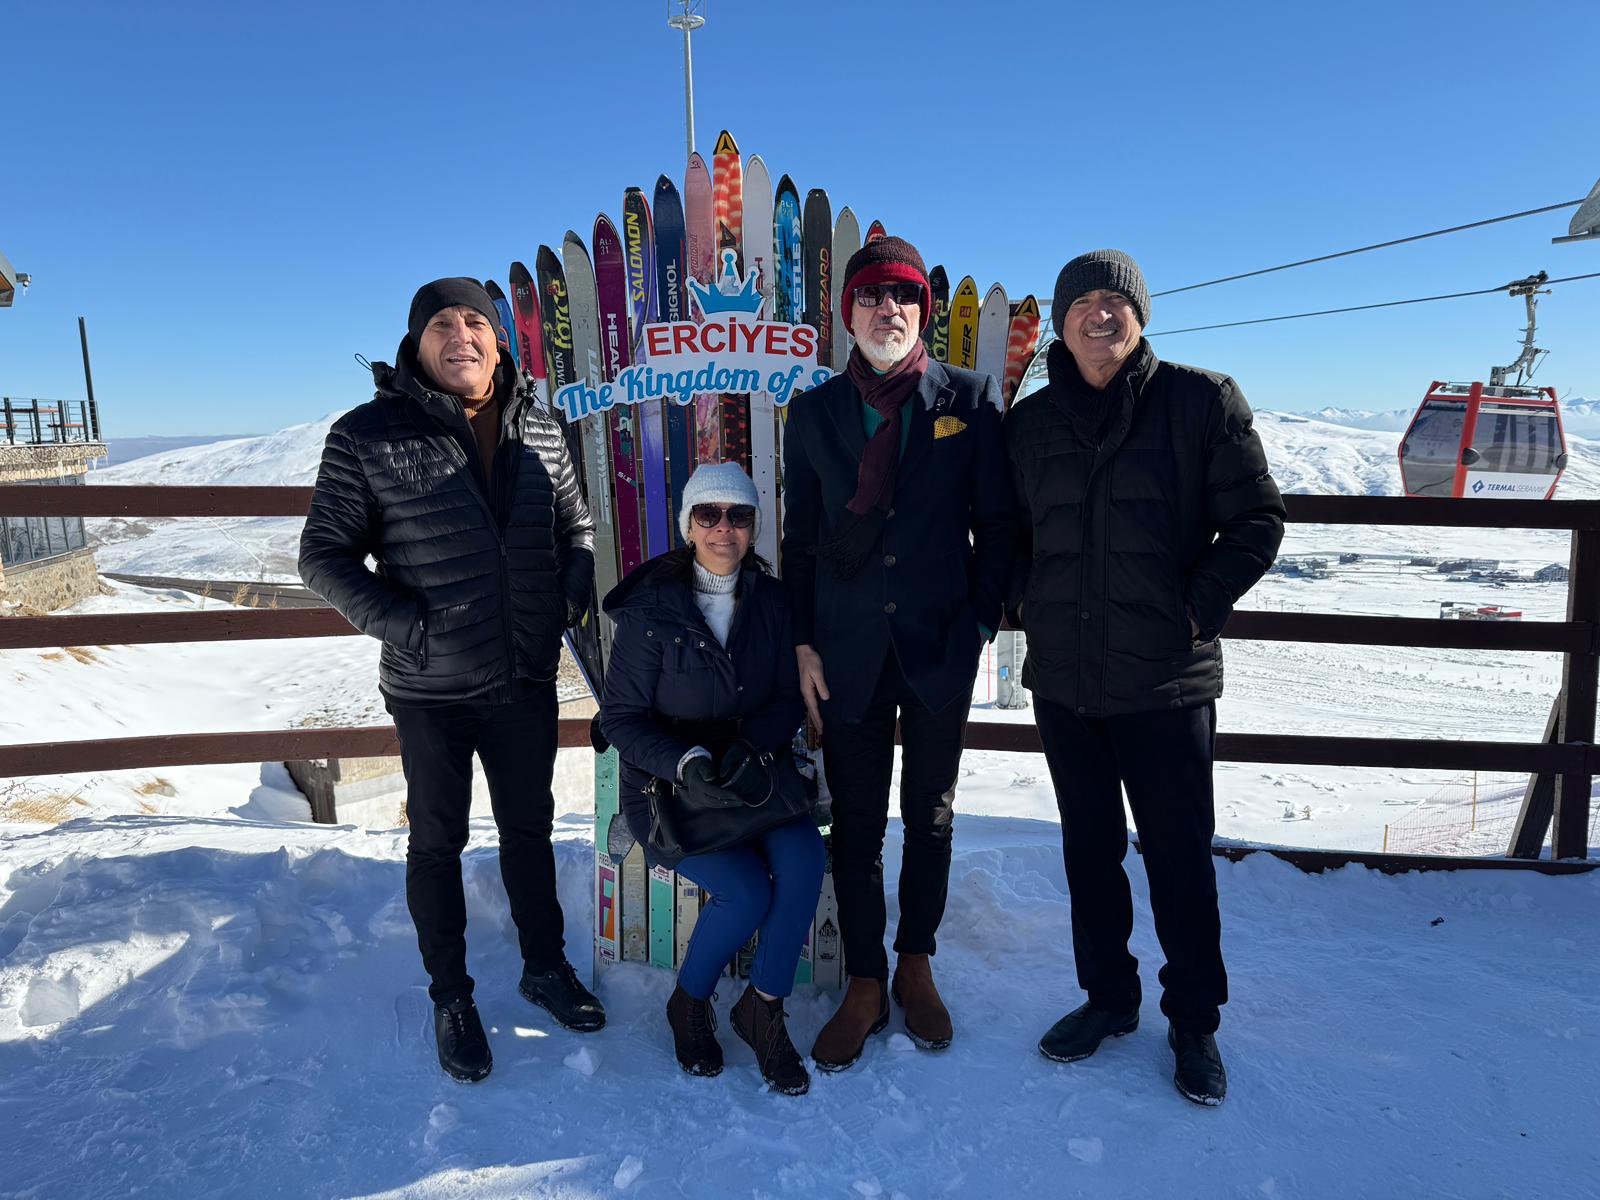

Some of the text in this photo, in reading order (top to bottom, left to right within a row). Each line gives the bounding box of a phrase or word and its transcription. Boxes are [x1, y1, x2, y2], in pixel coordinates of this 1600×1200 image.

[626, 211, 646, 303] SALOMON
[792, 243, 802, 324] ASTLE
[666, 258, 680, 323] SIGNOL
[645, 316, 815, 358] ERCİYES
[932, 298, 949, 362] orce
[961, 323, 973, 369] HER
[555, 351, 567, 387] OMON
[557, 378, 613, 419] The
[619, 360, 760, 400] Kingdom
[769, 364, 804, 402] of
[1487, 483, 1516, 492] TERMAL
